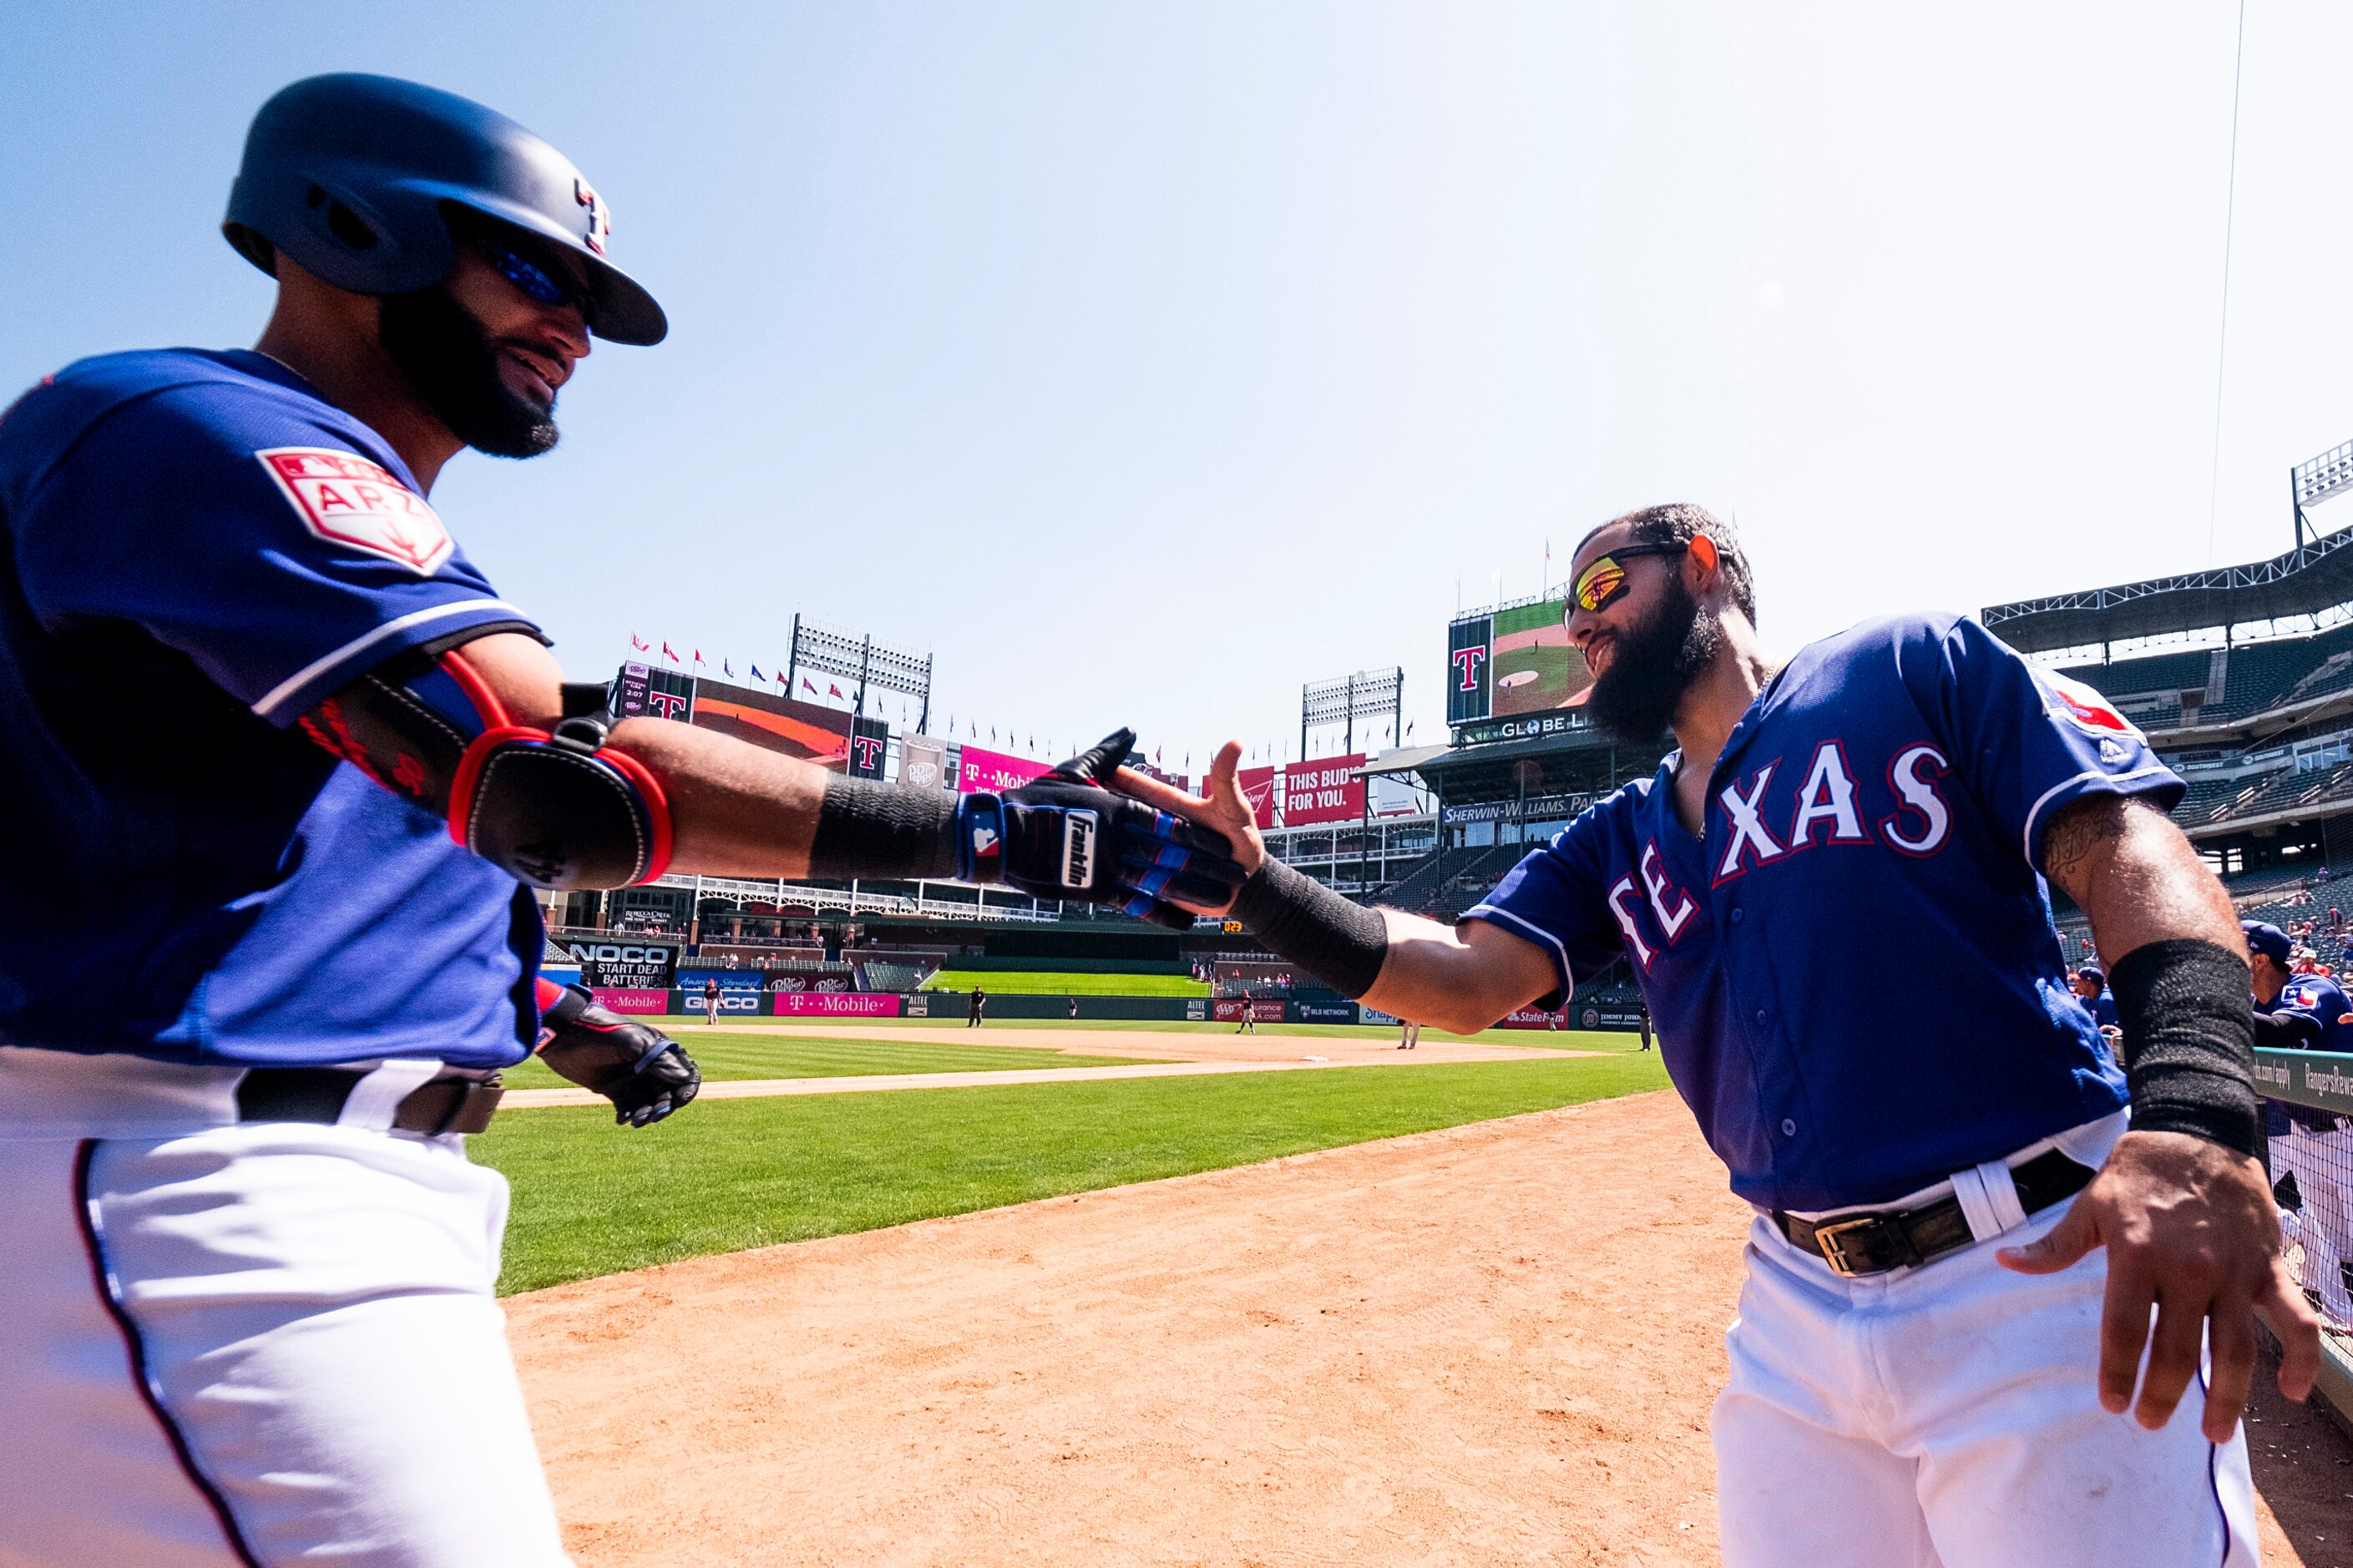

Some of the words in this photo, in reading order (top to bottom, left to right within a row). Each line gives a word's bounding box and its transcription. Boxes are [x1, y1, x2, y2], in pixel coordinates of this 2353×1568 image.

[1453, 645, 1485, 691] T
[626, 690, 643, 698] 2:07
[1501, 717, 1565, 737] GLOBE
[855, 736, 883, 770] T
[1288, 771, 1318, 792] THIS
[1288, 792, 1313, 812] FOR
[1316, 788, 1347, 808] YOU.
[1445, 800, 1565, 823] SHERWIN-WILIAMS
[1608, 738, 1954, 974] TEXAS
[569, 943, 669, 964] NOCO
[598, 963, 635, 974] START
[637, 964, 667, 975] DEAD
[681, 977, 718, 986] Americ
[686, 996, 758, 1009] GCO
[2305, 1062, 2353, 1097] RangersRewa
